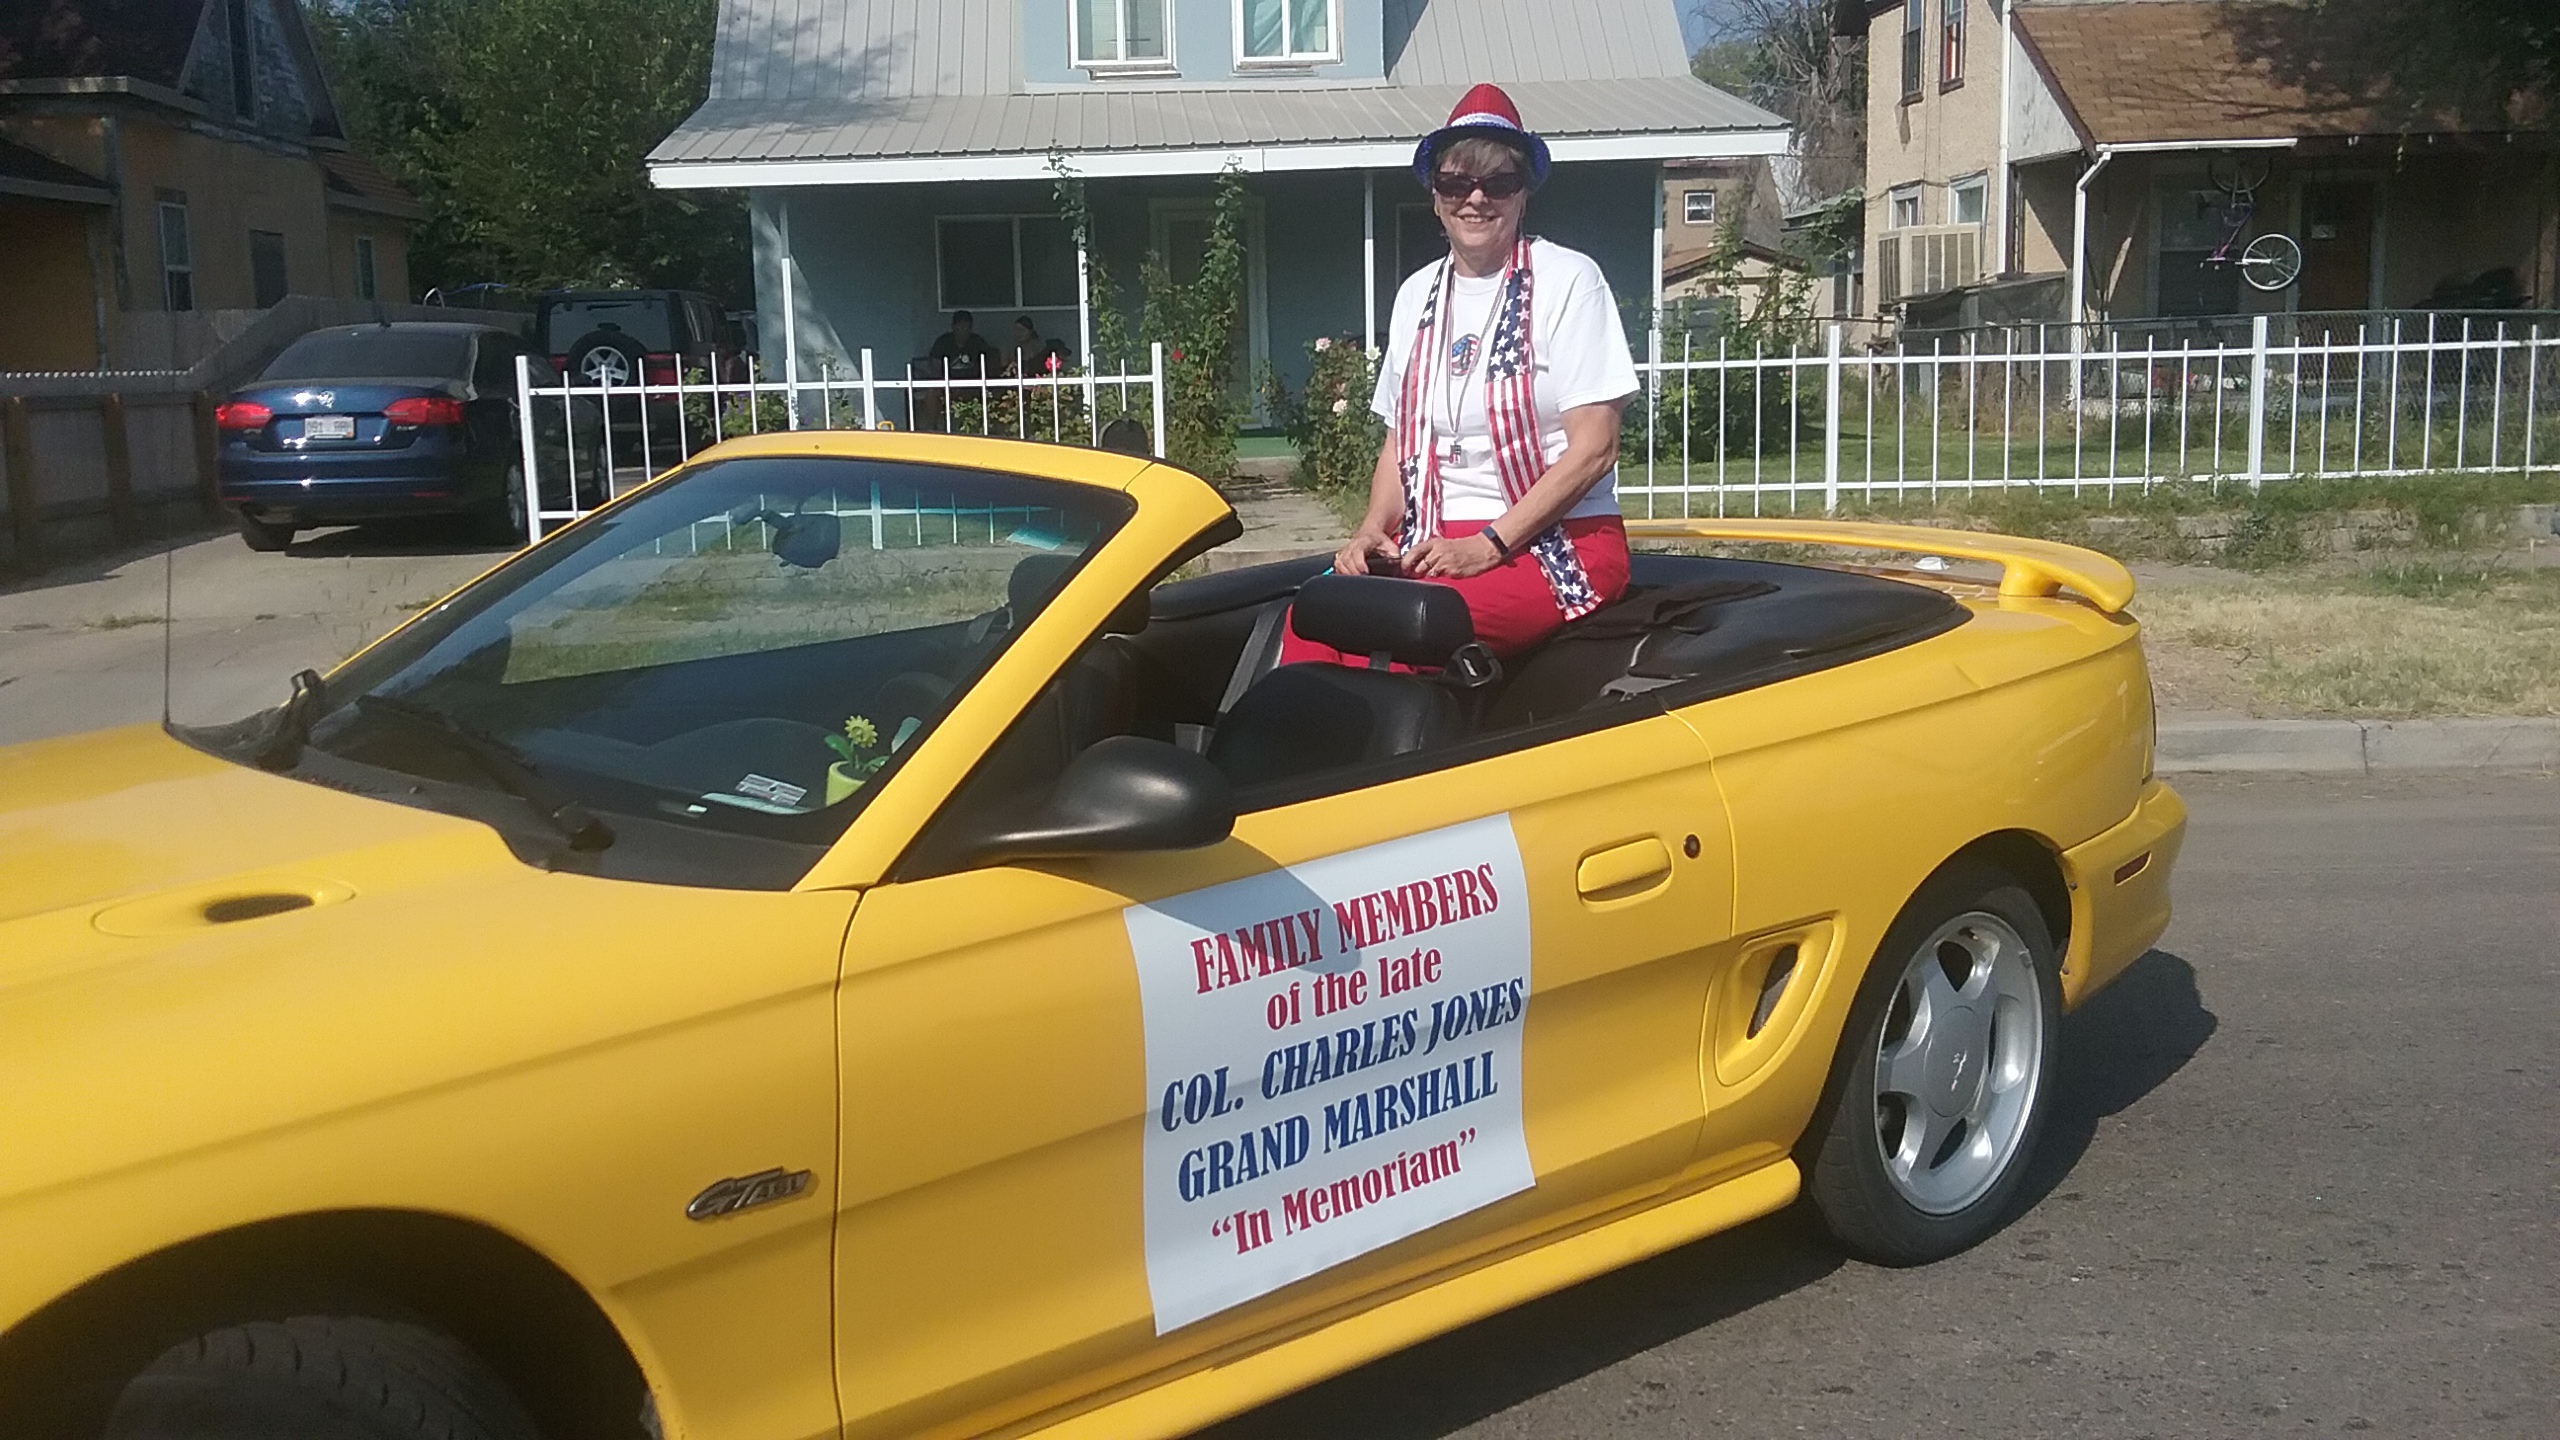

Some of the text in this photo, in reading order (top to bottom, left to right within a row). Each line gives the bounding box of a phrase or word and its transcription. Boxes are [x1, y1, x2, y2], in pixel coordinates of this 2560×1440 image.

[1190, 862, 1499, 995] FAMILY MEMBERS
[1266, 946, 1442, 1031] of the late
[1160, 976, 1524, 1132] COL. CHARLES JONES
[1178, 1050, 1498, 1203] GRAND MARSHALL
[1211, 1127, 1476, 1256] “In Memoriam”
